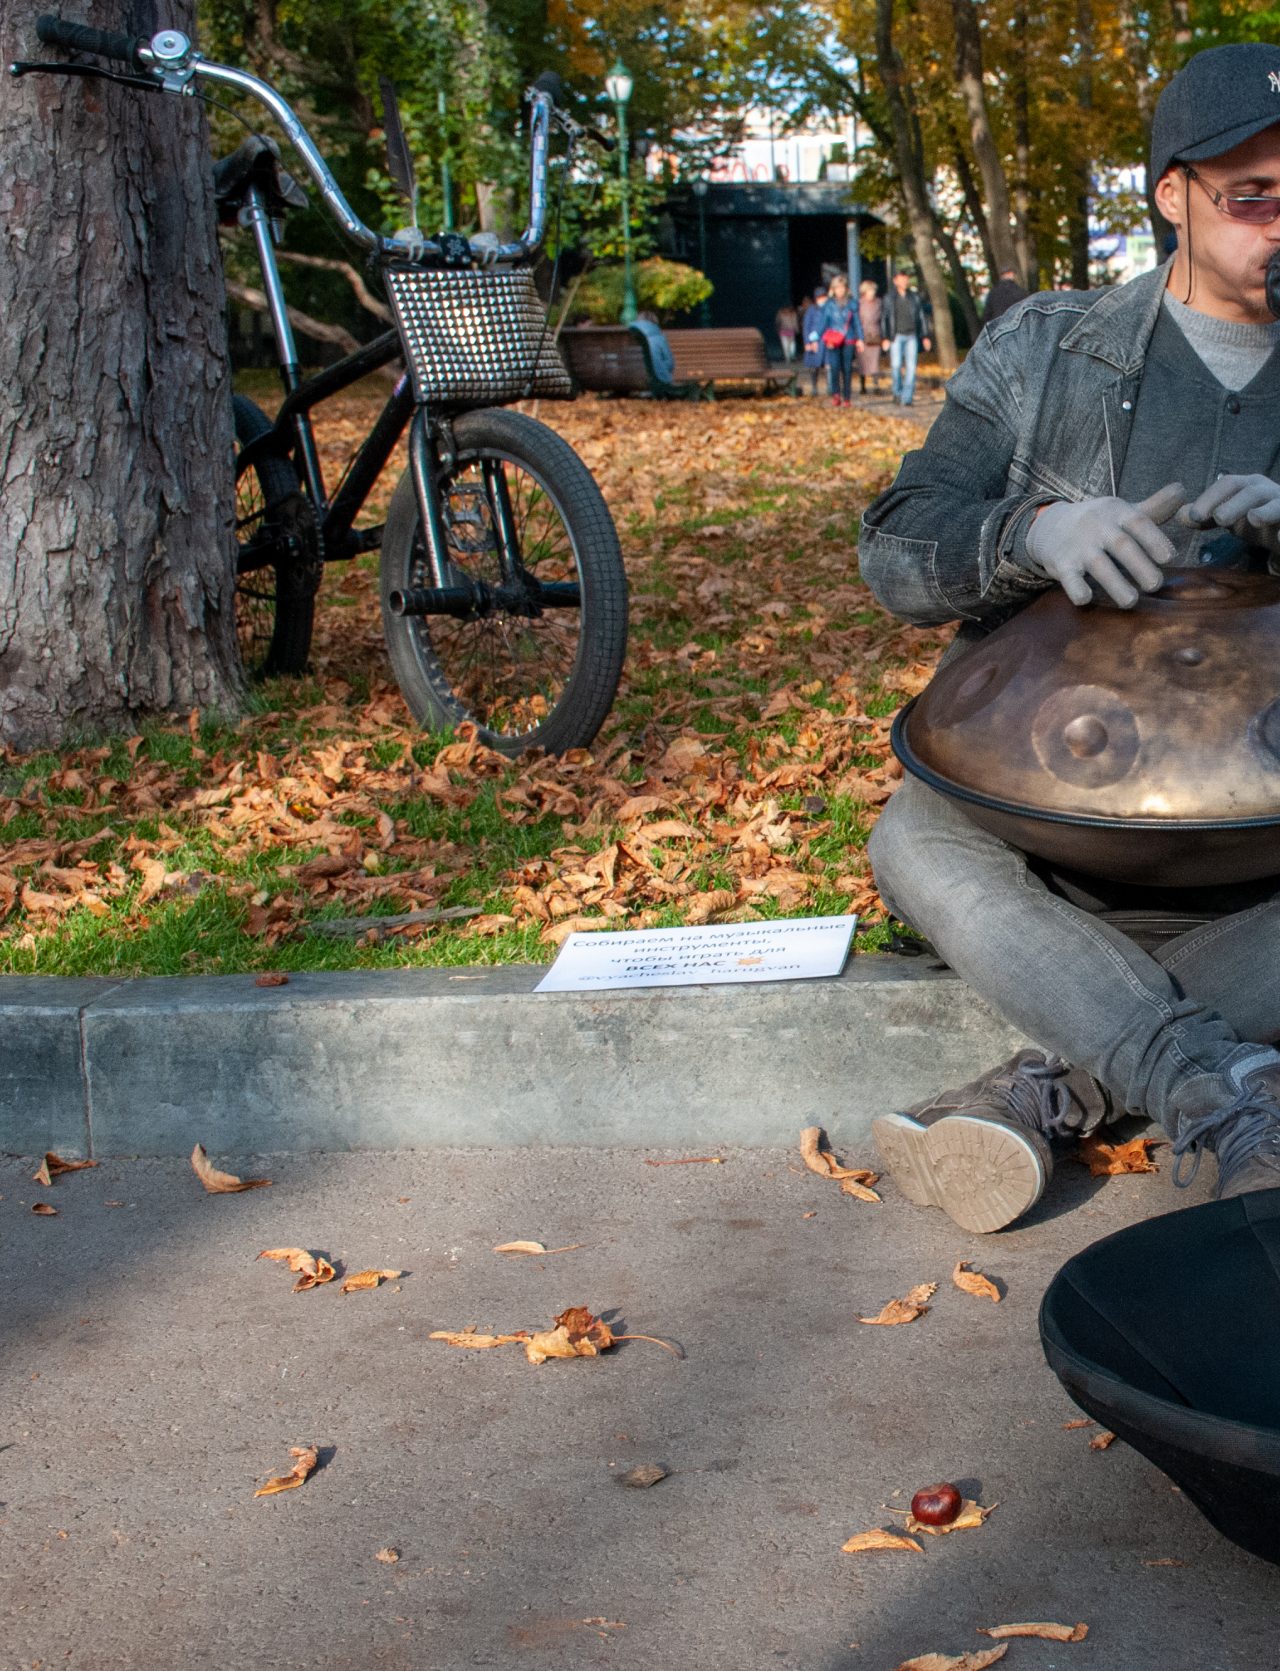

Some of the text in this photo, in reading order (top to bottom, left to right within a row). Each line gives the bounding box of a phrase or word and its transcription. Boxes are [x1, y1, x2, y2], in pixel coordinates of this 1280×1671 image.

[573, 937, 673, 947] Собираем
[709, 923, 846, 940] музыкальные
[611, 946, 786, 964] чтобы играть для
[625, 960, 727, 972] ВСЕХ НАС
